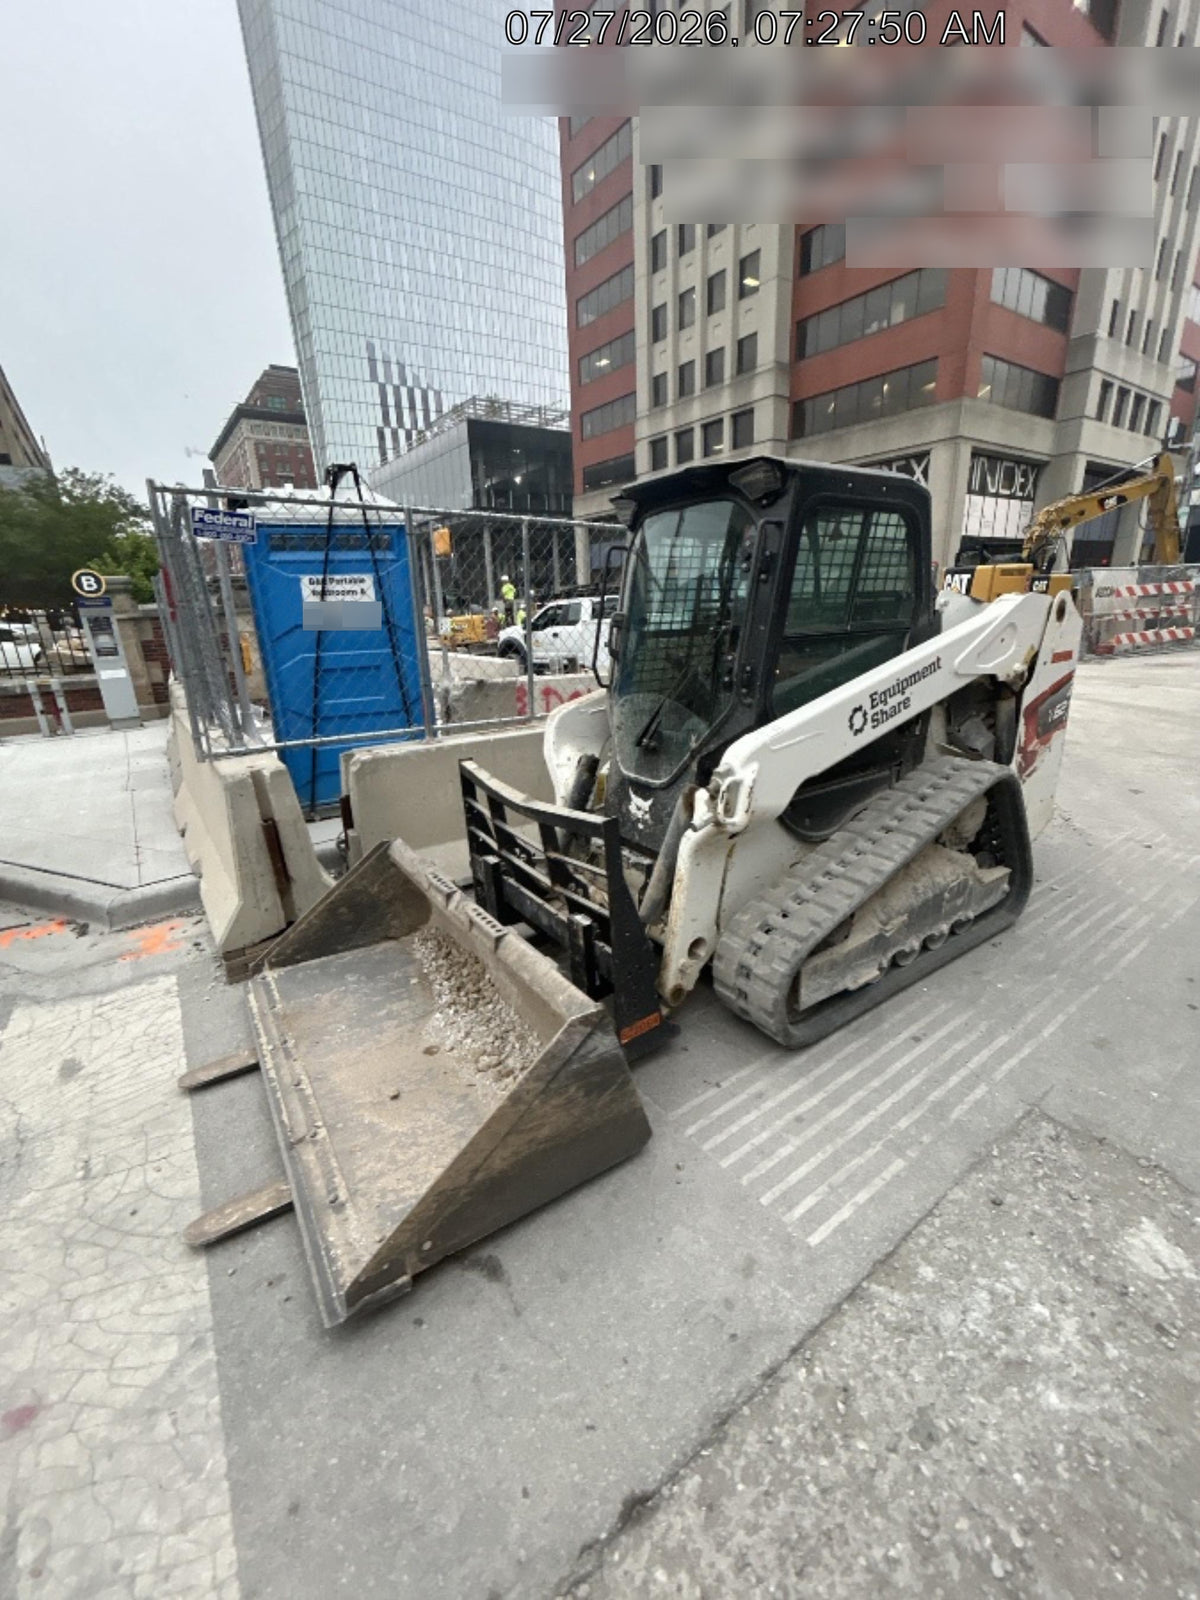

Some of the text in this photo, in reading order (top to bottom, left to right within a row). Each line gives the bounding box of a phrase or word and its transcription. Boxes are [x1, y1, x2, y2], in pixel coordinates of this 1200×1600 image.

[970, 455, 1038, 498] INDEX
[194, 509, 254, 529] Federal
[81, 575, 98, 591] B
[869, 655, 942, 710] Equipment
[871, 696, 911, 729] Share
